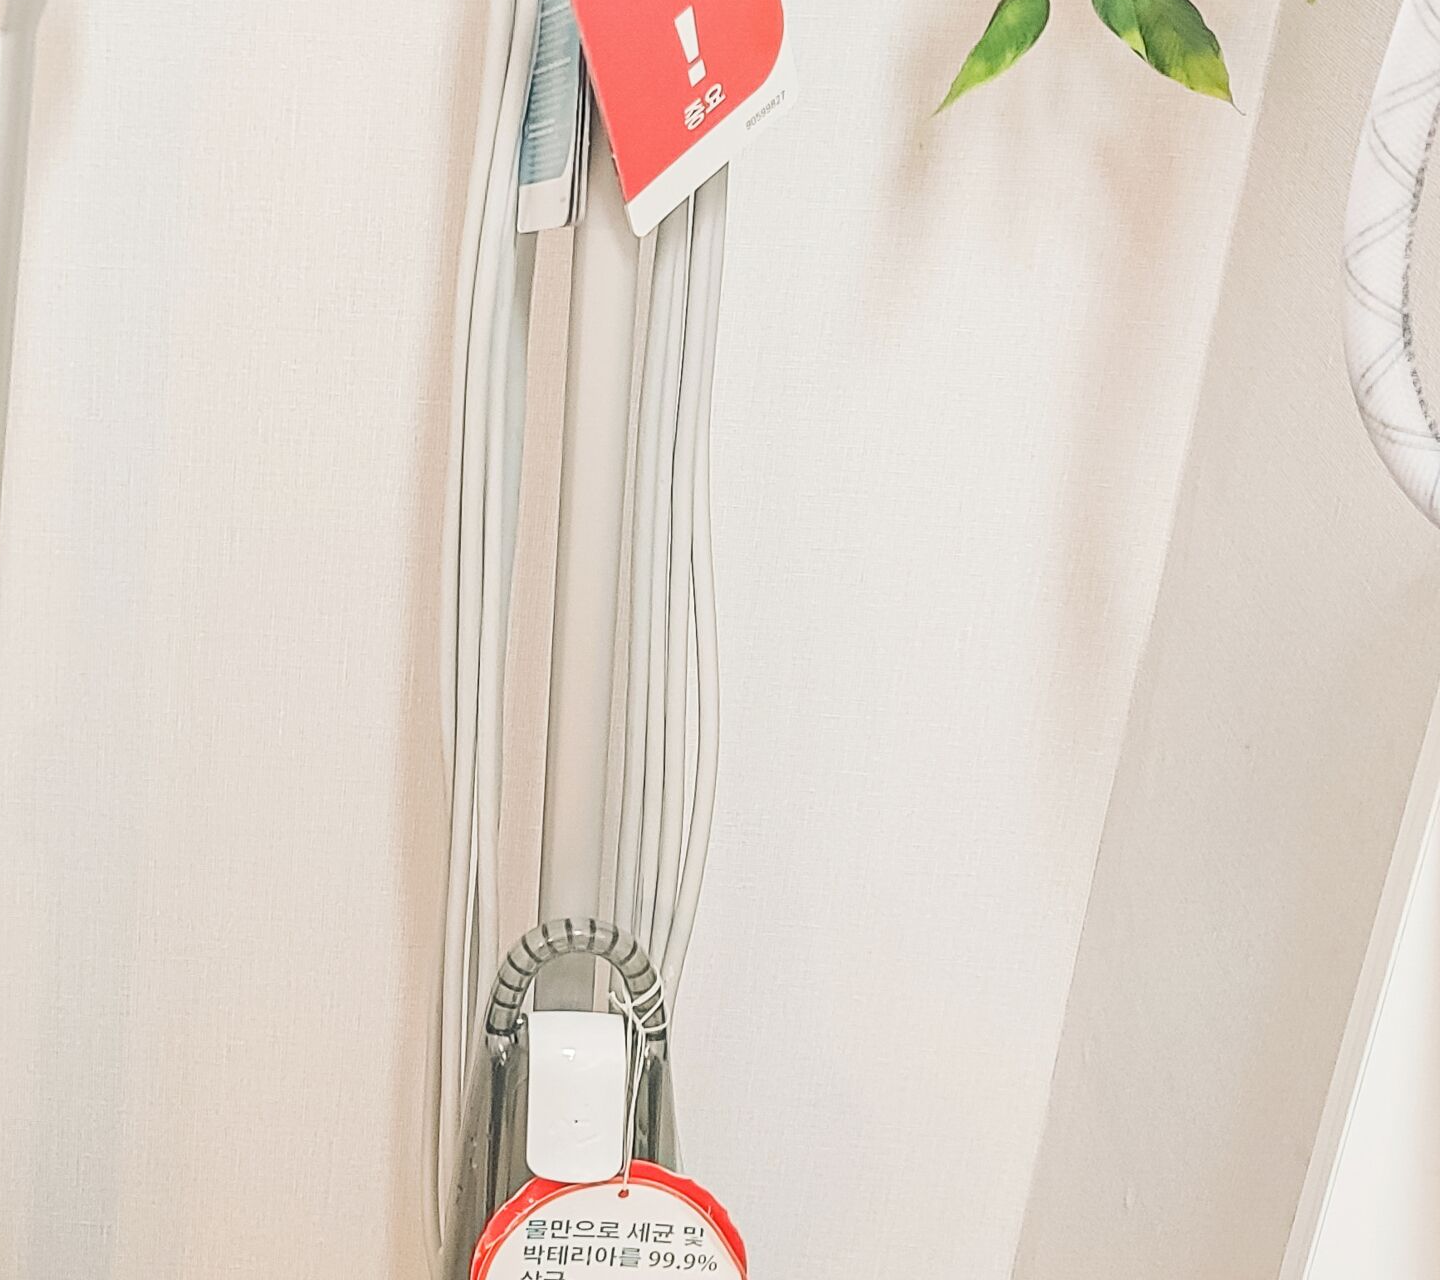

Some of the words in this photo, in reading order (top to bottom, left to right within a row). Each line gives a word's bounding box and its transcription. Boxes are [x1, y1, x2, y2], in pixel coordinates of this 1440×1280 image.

[684, 82, 727, 131] 중요
[525, 1219, 620, 1240] 물만으로
[627, 1221, 674, 1244] 세균
[684, 1225, 704, 1247] 및
[523, 1244, 641, 1268] 박테리아를
[648, 1250, 718, 1272] 99.9%
